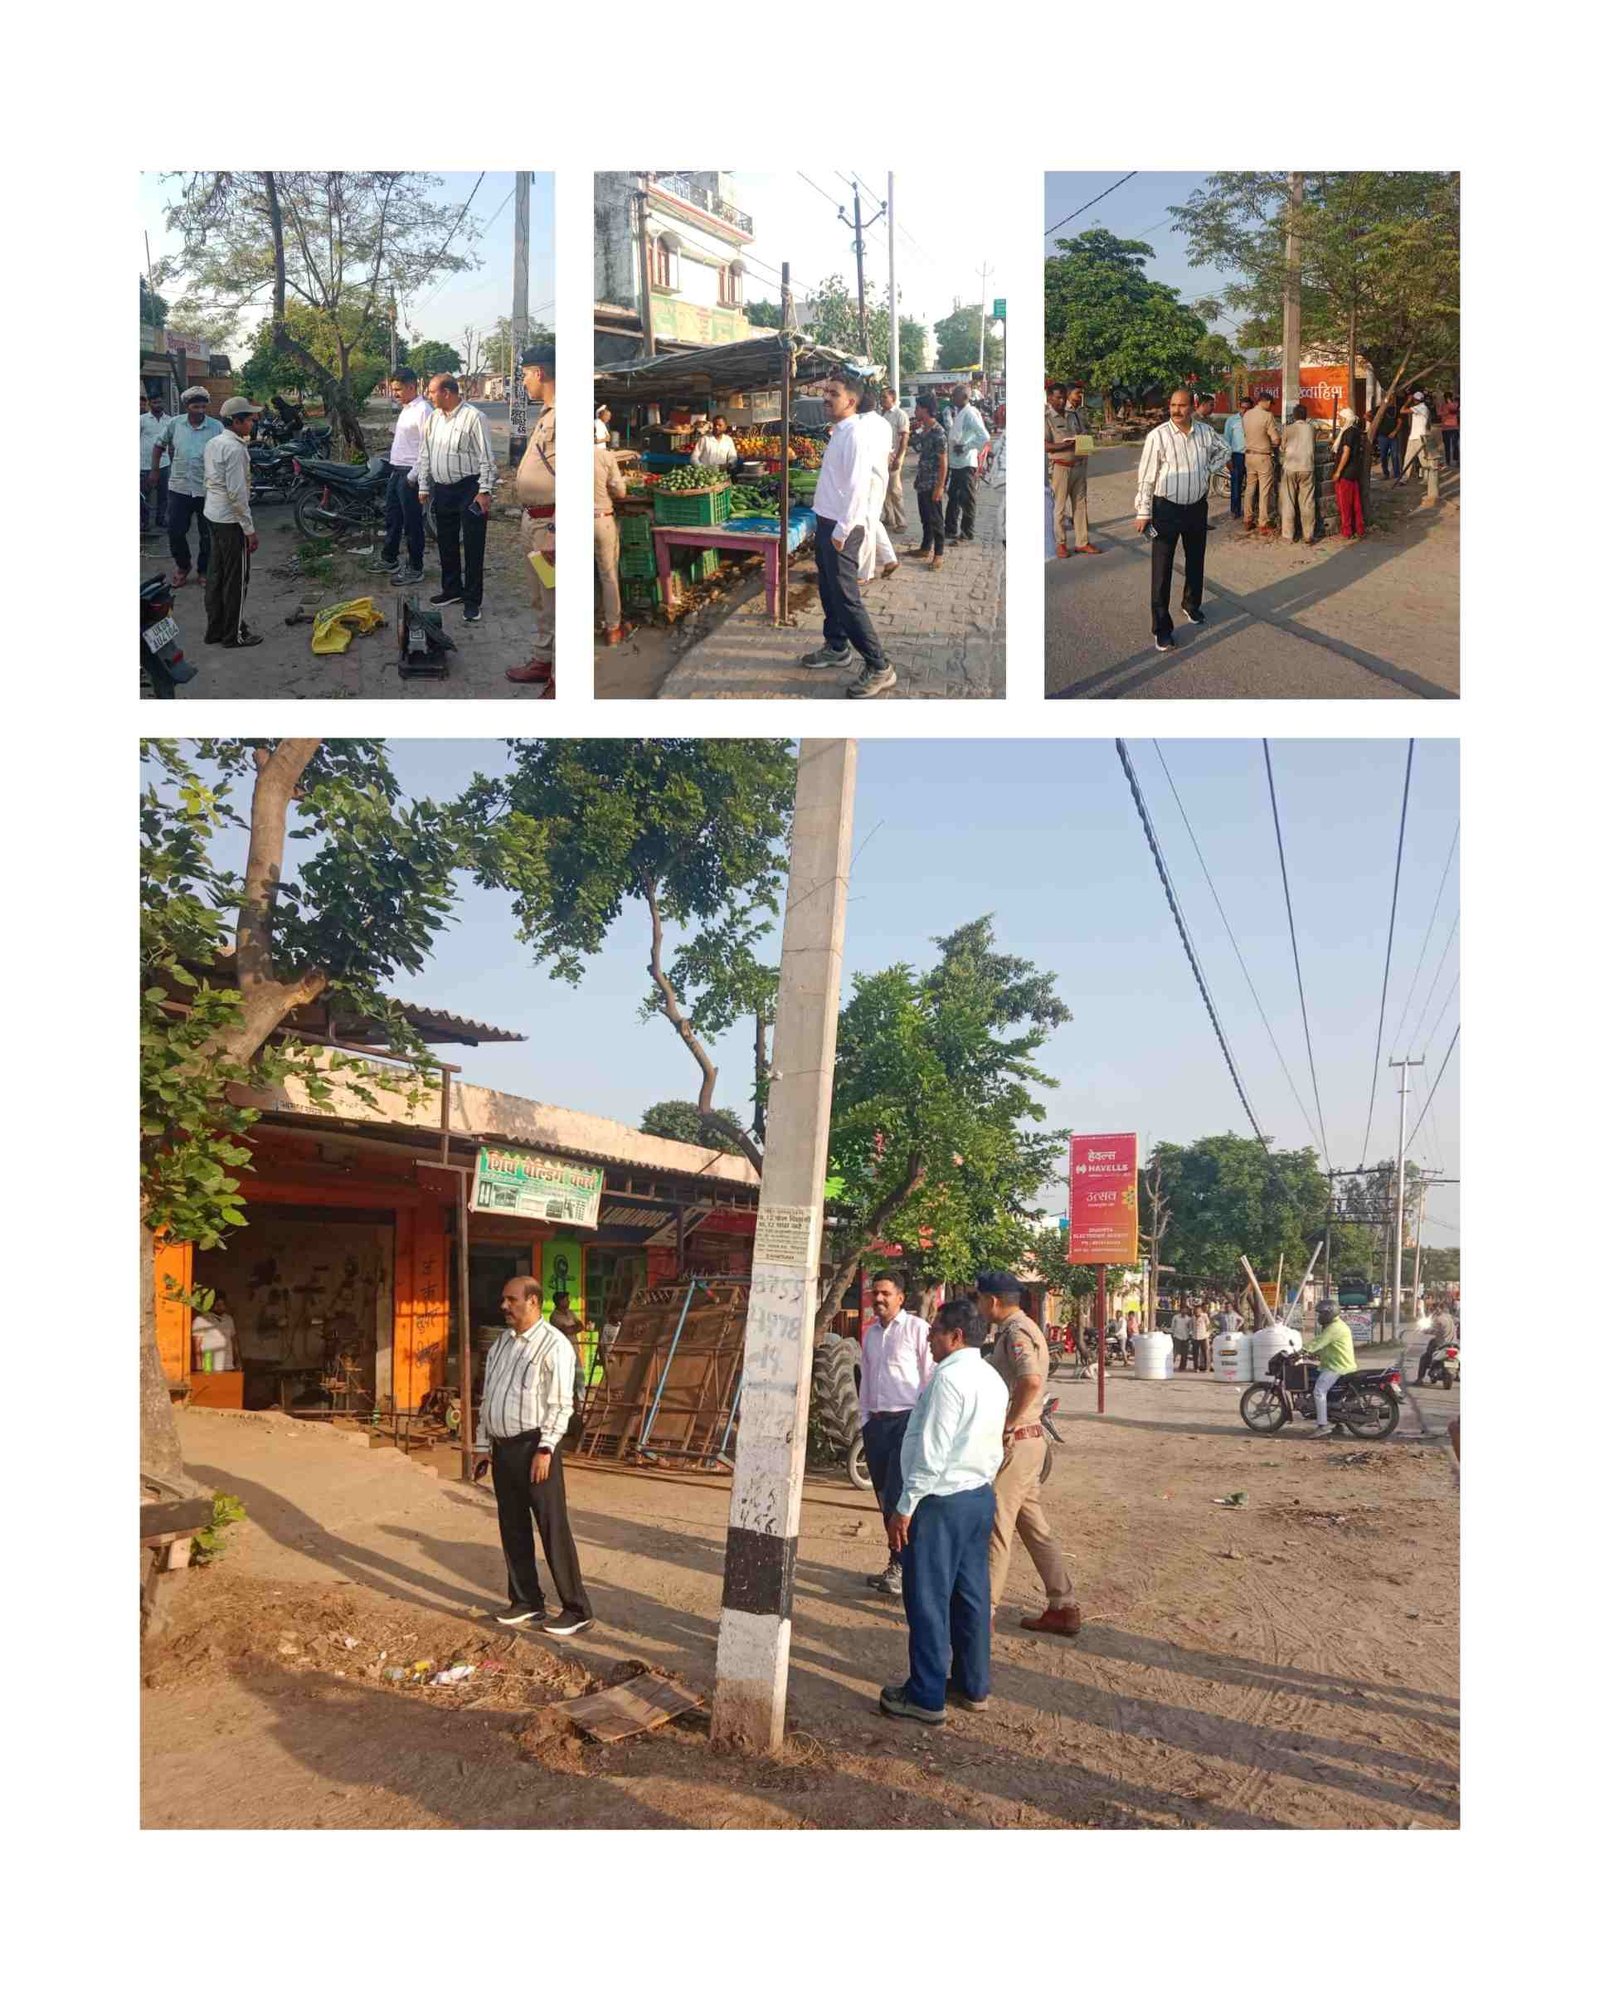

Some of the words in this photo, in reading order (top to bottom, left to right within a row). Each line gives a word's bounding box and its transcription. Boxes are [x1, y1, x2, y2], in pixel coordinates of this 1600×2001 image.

[487, 1150, 516, 1173] शिव
[1088, 1164, 1128, 1172] HAVELLS
[1087, 1191, 1117, 1202] उत्सव
